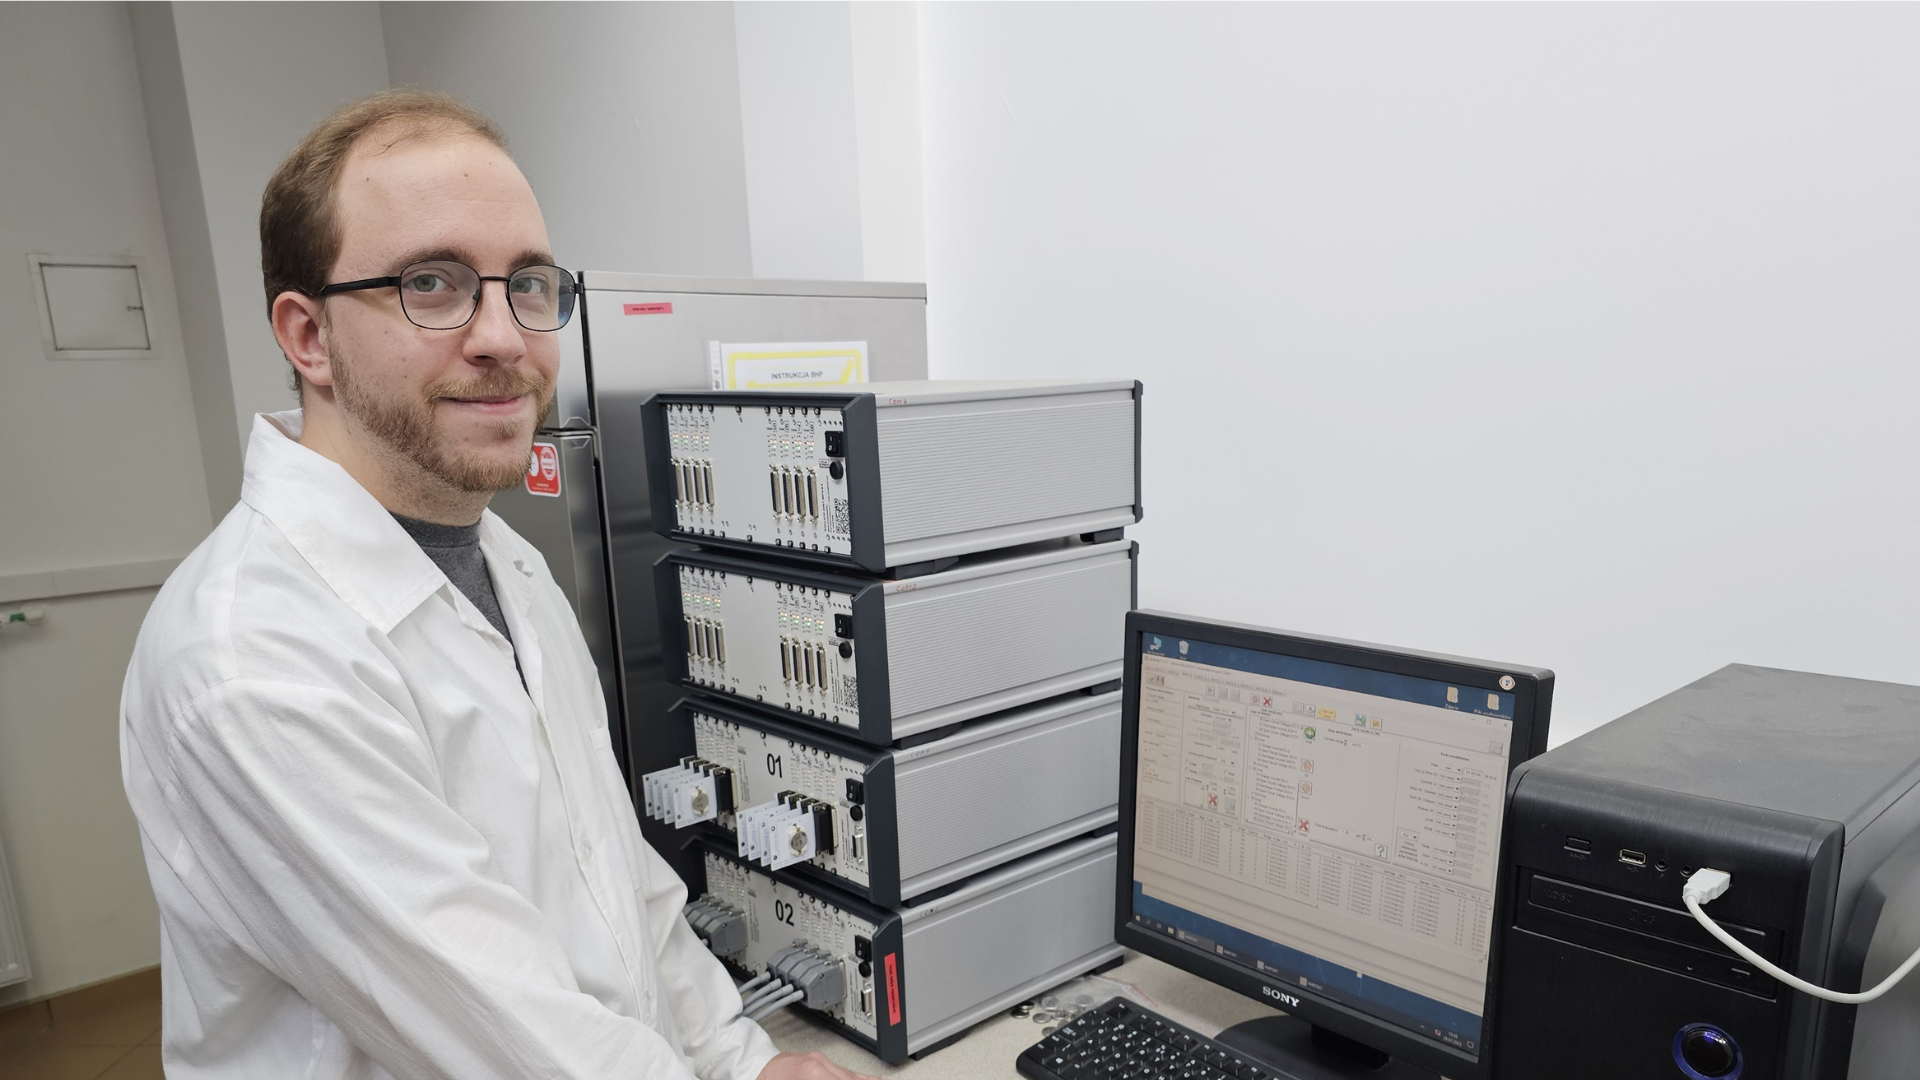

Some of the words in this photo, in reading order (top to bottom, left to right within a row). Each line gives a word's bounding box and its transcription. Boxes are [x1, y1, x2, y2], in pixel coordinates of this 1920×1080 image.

[771, 372, 810, 380] INSTRUKCJA
[767, 753, 782, 778] 01
[775, 899, 794, 926] 02
[1263, 986, 1300, 1007] SONY
